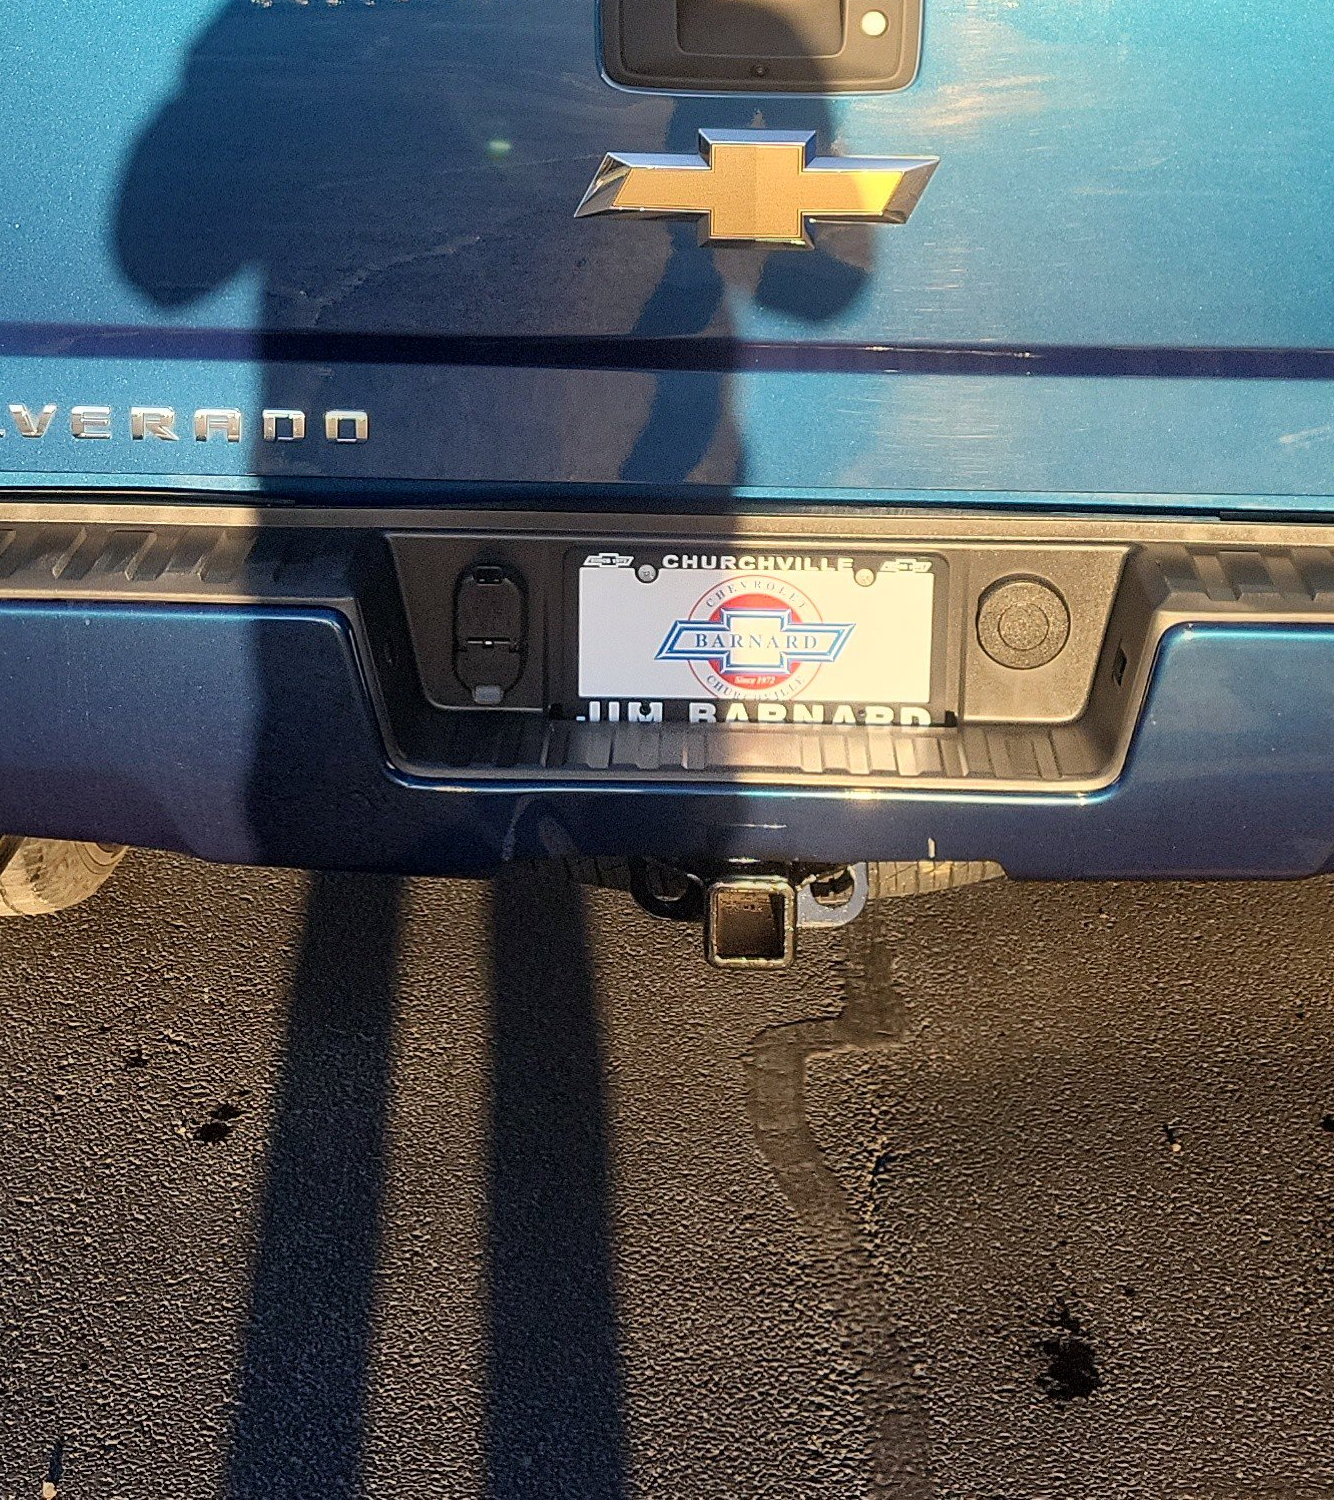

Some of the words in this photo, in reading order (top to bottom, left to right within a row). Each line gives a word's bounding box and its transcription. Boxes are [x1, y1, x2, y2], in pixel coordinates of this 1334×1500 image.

[662, 554, 854, 572] CHURCHVILLE
[705, 580, 807, 608] CHEVROLET
[695, 633, 818, 649] BARNARD
[688, 701, 931, 728] BARNARD
